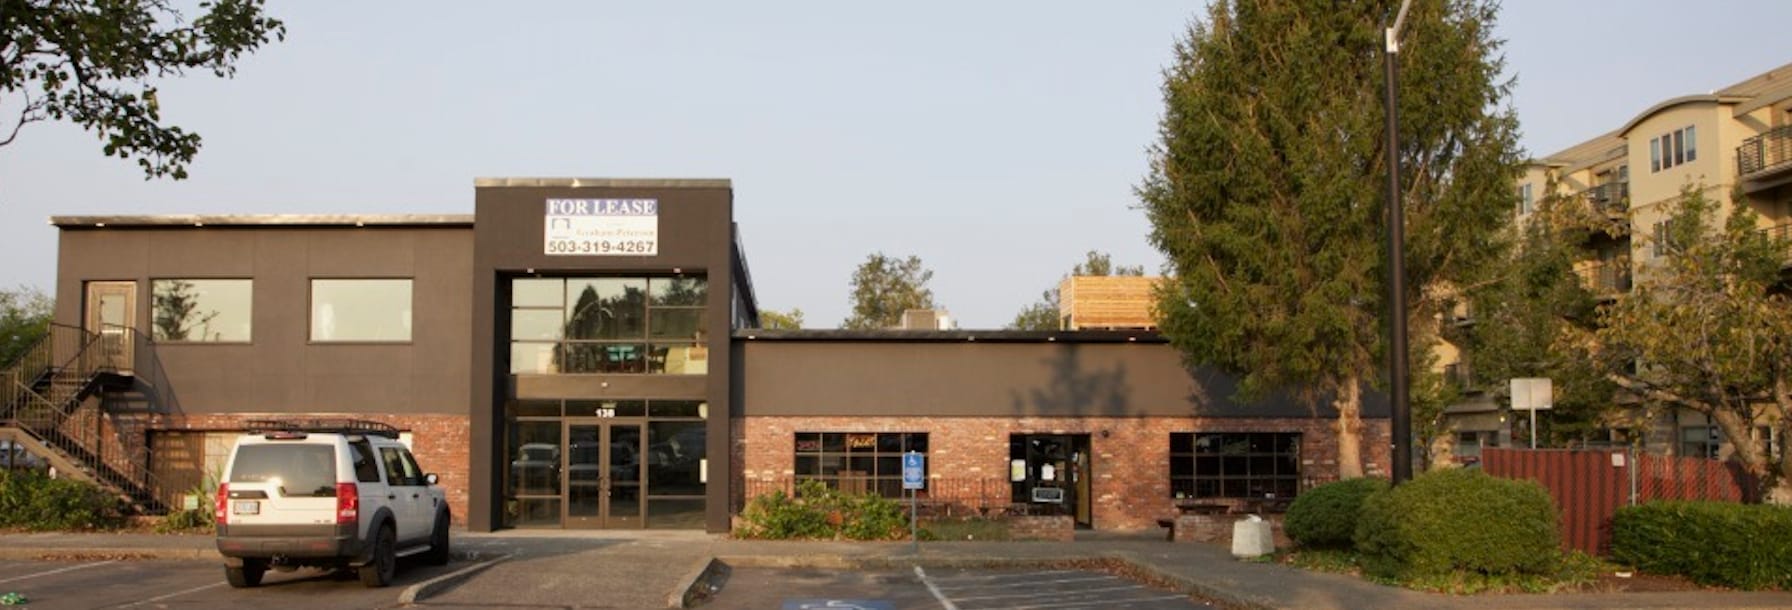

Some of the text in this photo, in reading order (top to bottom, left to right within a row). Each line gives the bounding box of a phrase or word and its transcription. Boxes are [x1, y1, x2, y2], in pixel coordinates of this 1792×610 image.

[549, 200, 656, 214] FOR LEASE
[549, 240, 654, 252] 503-319-4267
